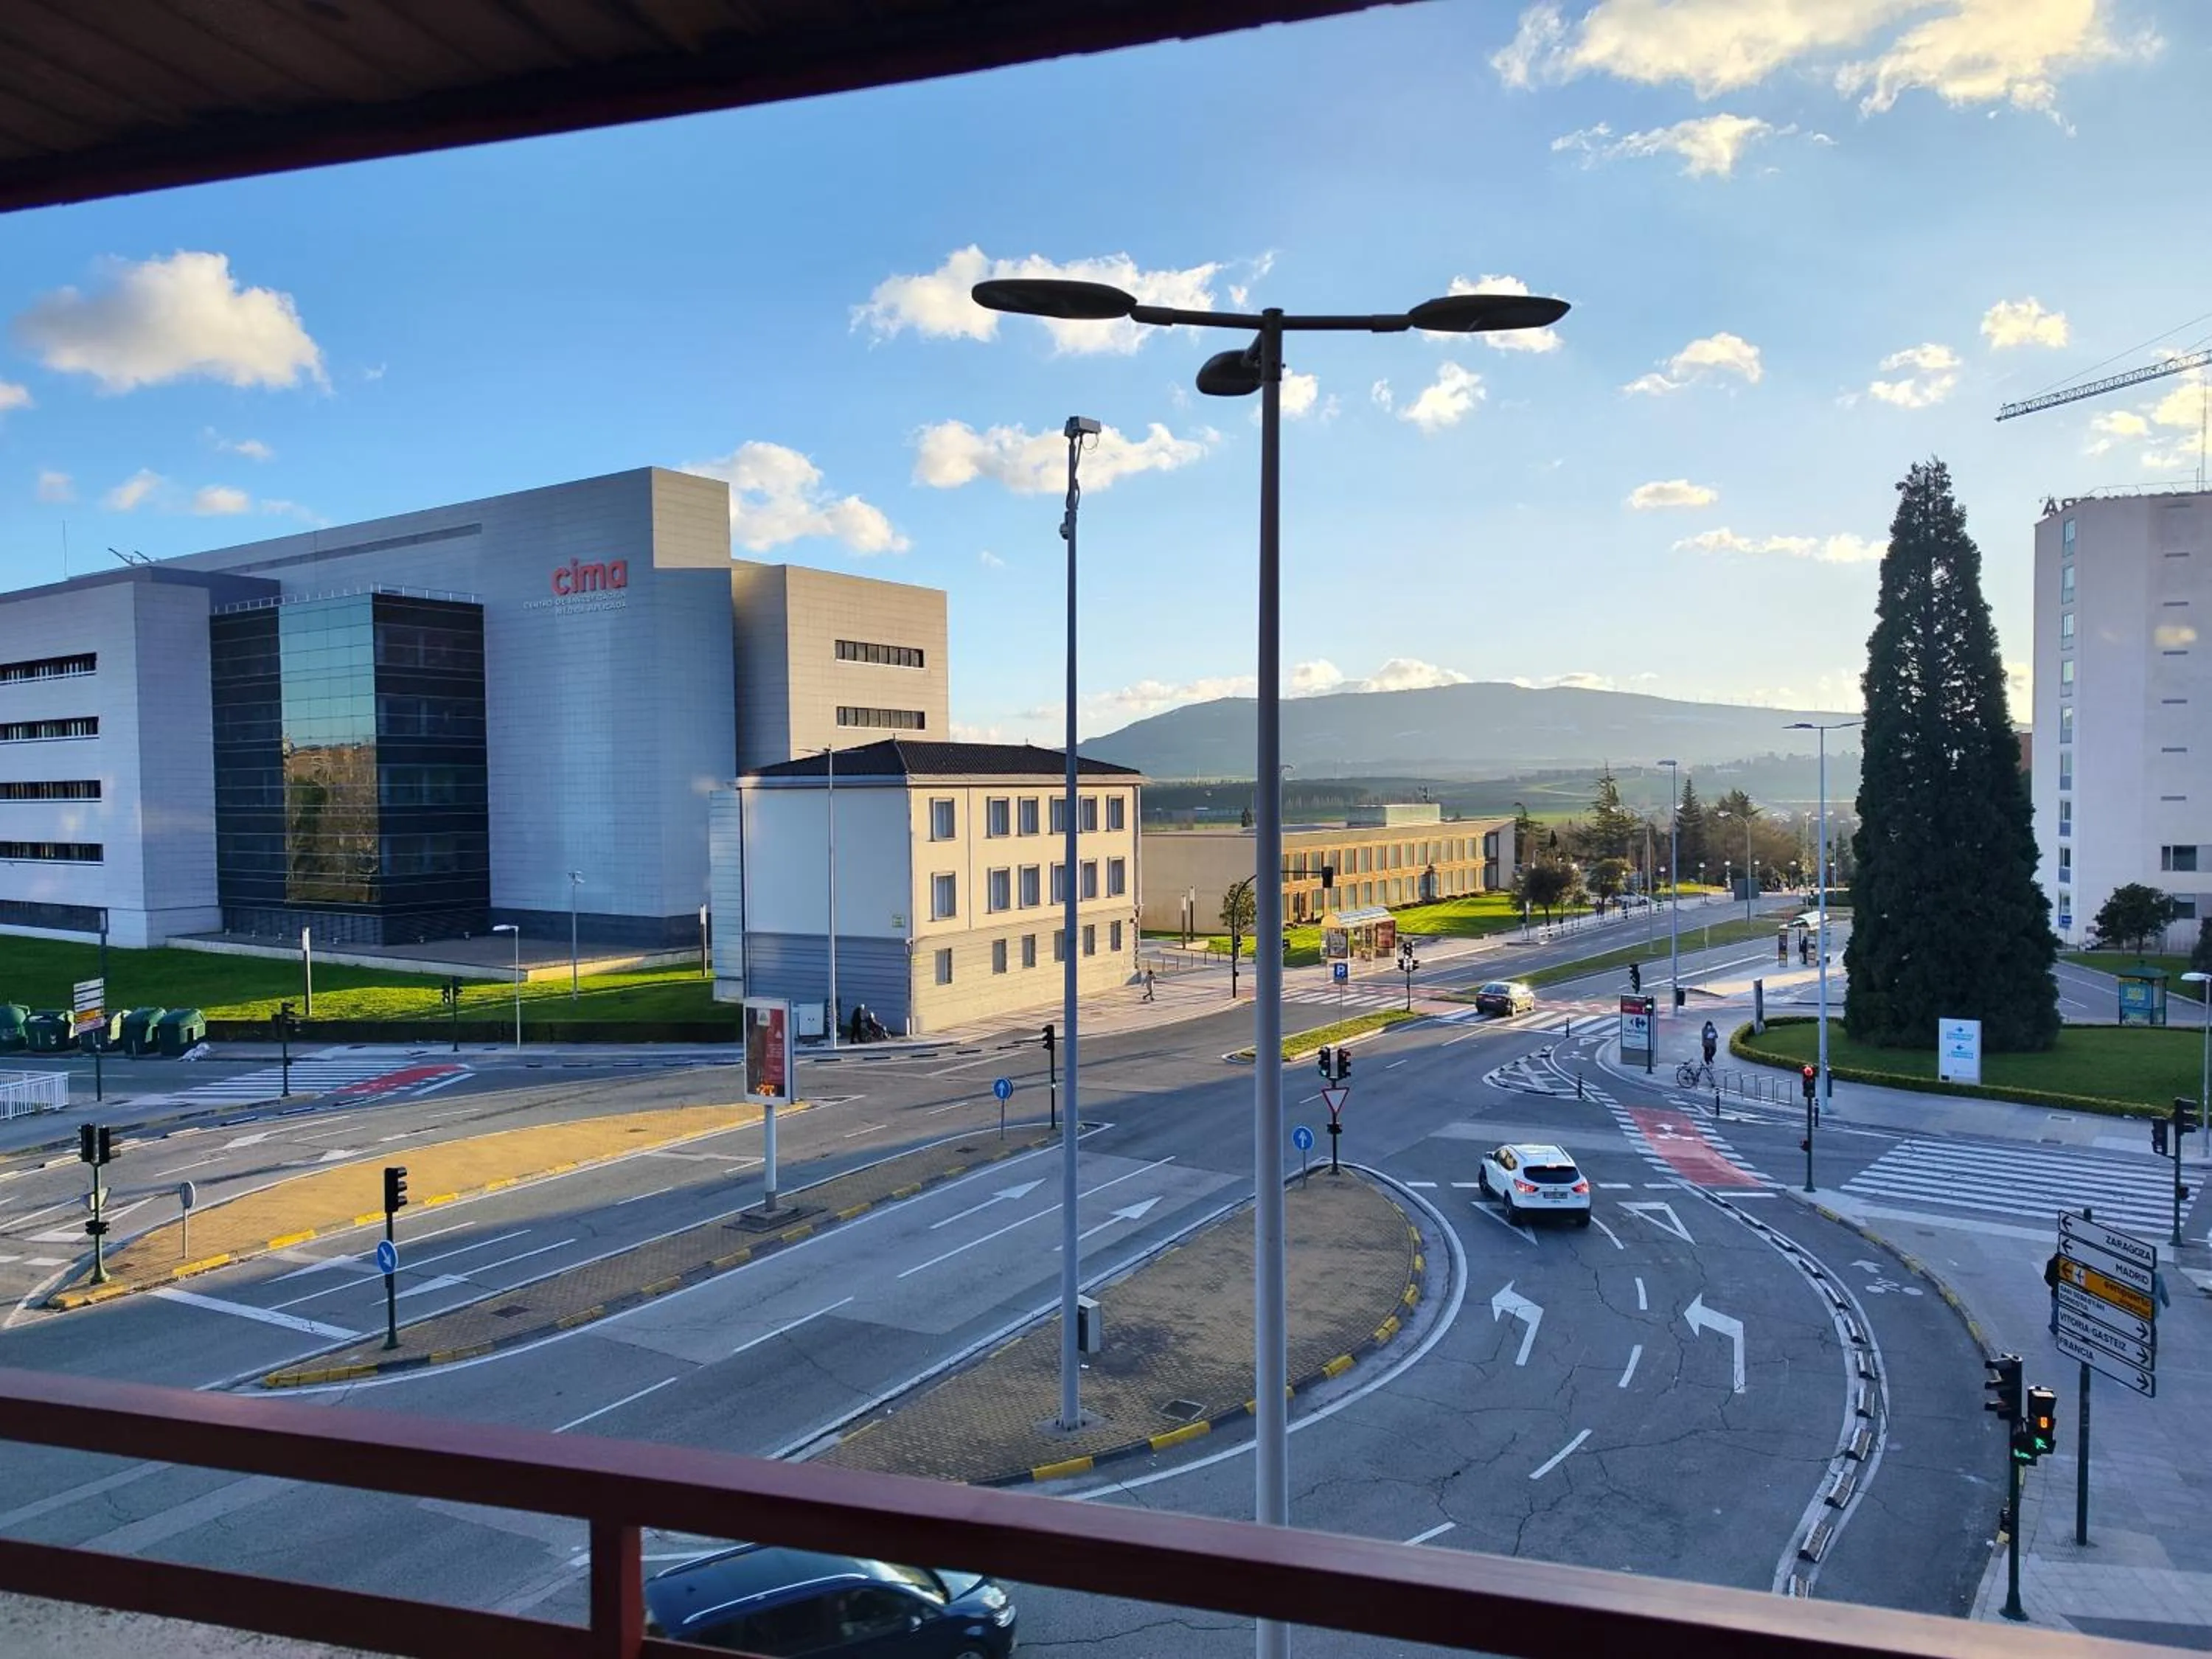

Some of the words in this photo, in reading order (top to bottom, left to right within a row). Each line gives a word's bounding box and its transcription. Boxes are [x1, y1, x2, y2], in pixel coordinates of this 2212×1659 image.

[552, 557, 628, 596] cima
[2105, 1234, 2152, 1262] ZARAGOZA
[2115, 1262, 2149, 1285] MADRID
[2059, 1335, 2094, 1360] FRANCIA
